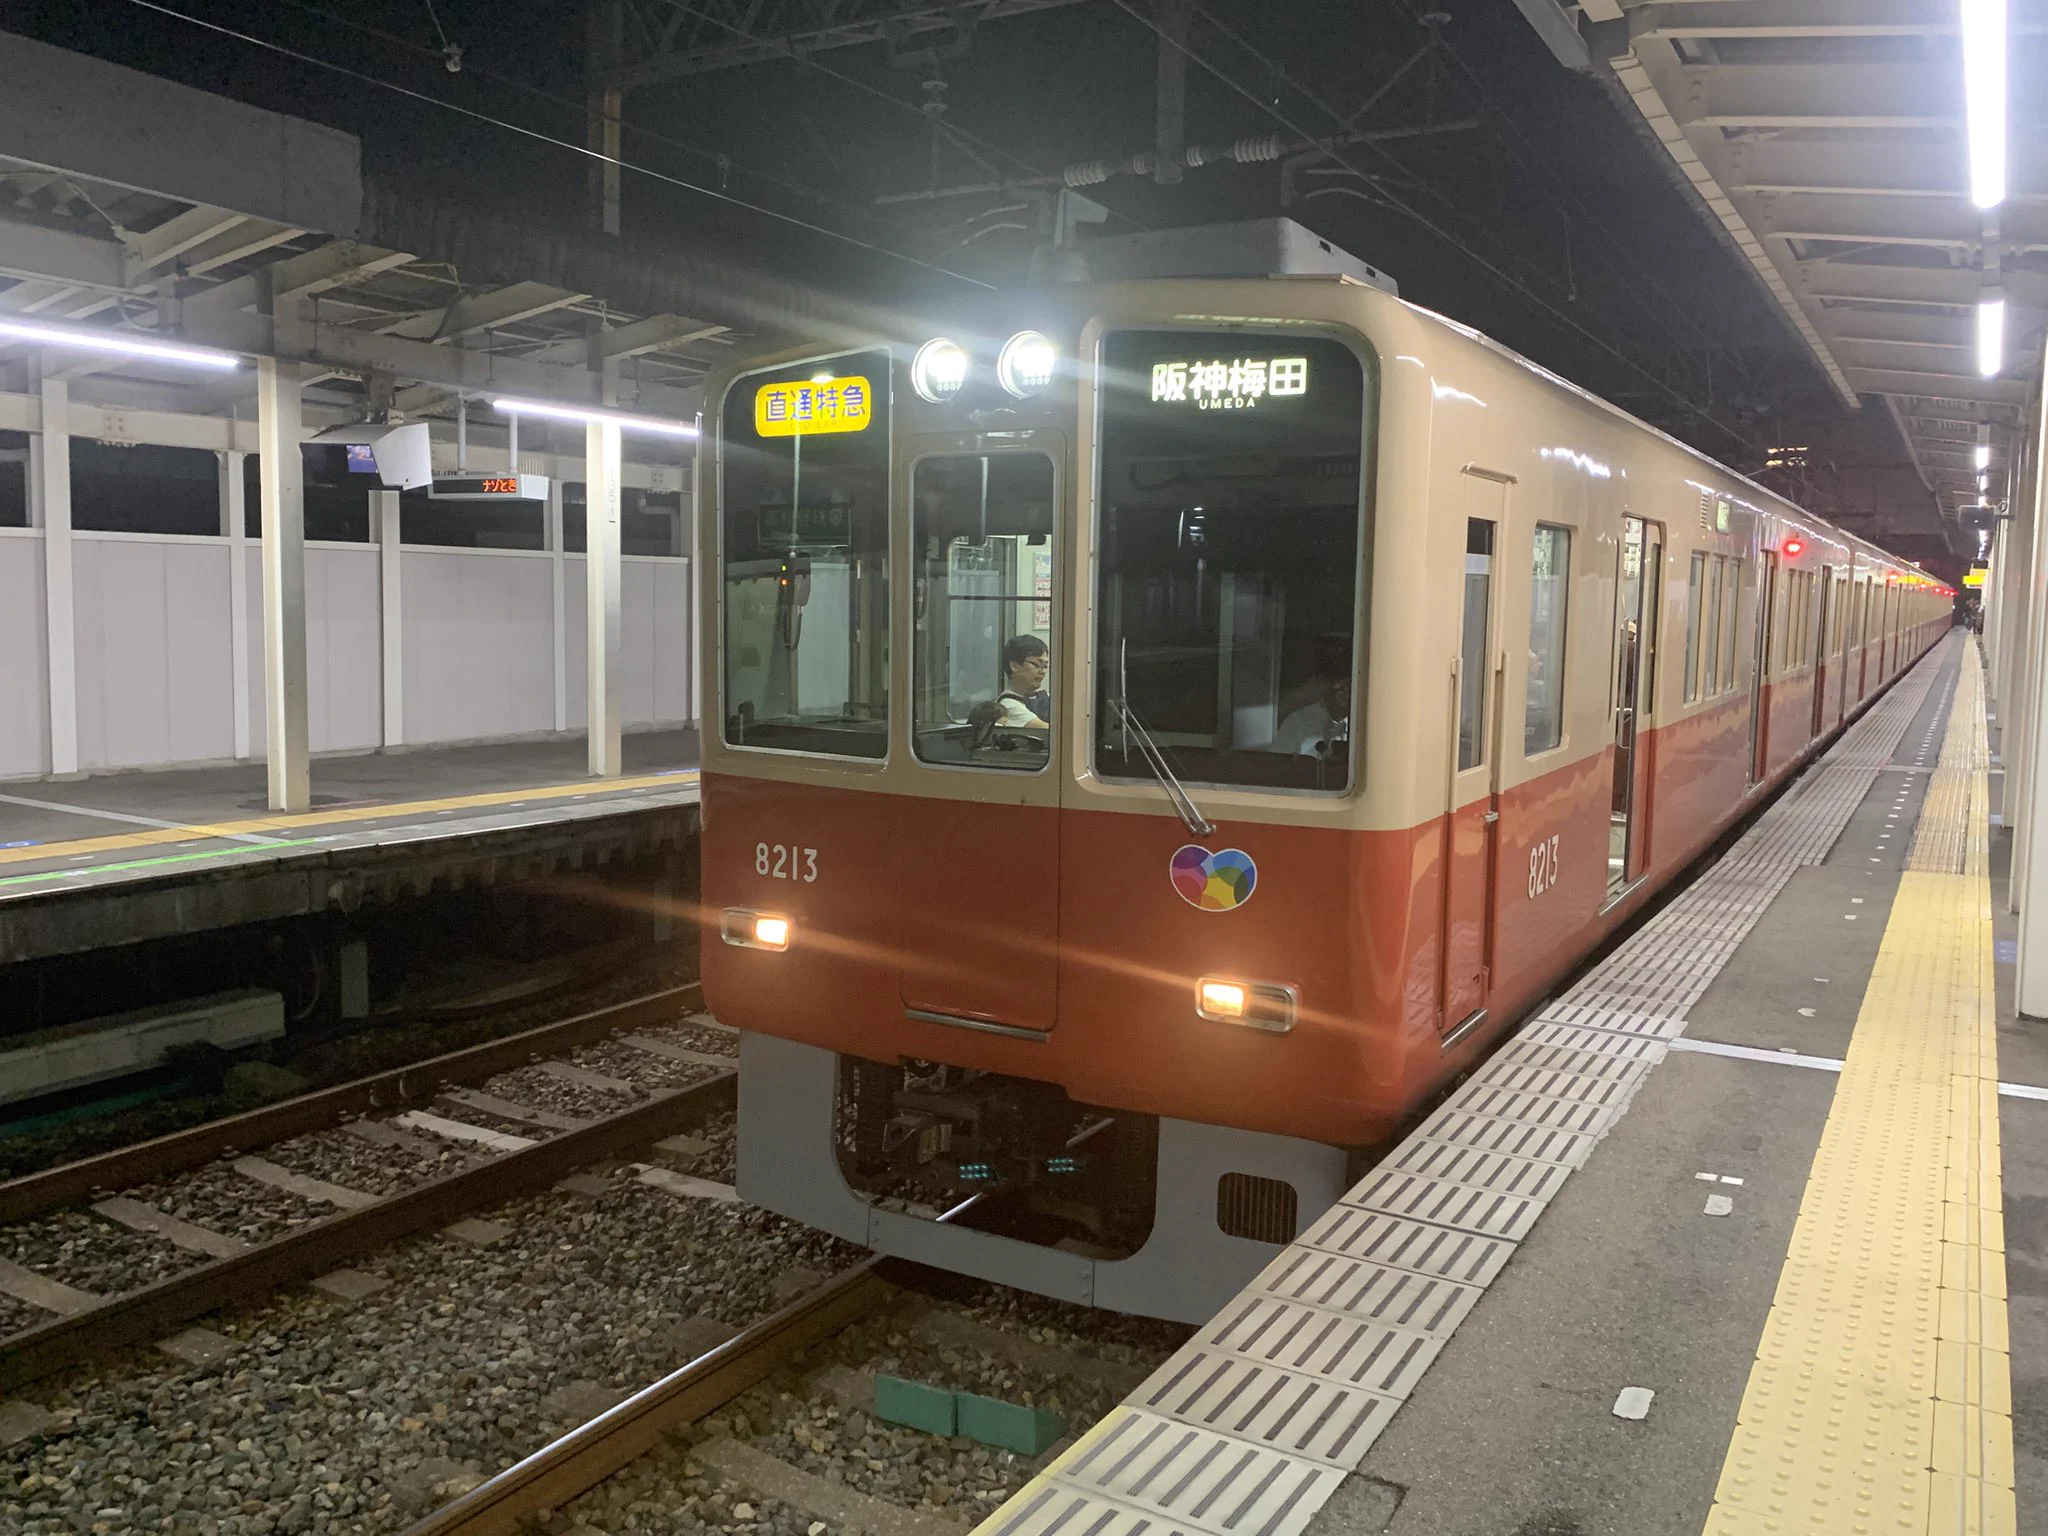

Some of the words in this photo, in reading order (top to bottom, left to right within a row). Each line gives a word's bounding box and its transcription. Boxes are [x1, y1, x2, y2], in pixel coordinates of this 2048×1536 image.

[1152, 358, 1307, 401] 阪神梅田
[766, 384, 865, 421] 直通特急
[1199, 397, 1255, 410] UMEDA
[756, 842, 818, 883] 8213
[1528, 833, 1559, 899] 8213
